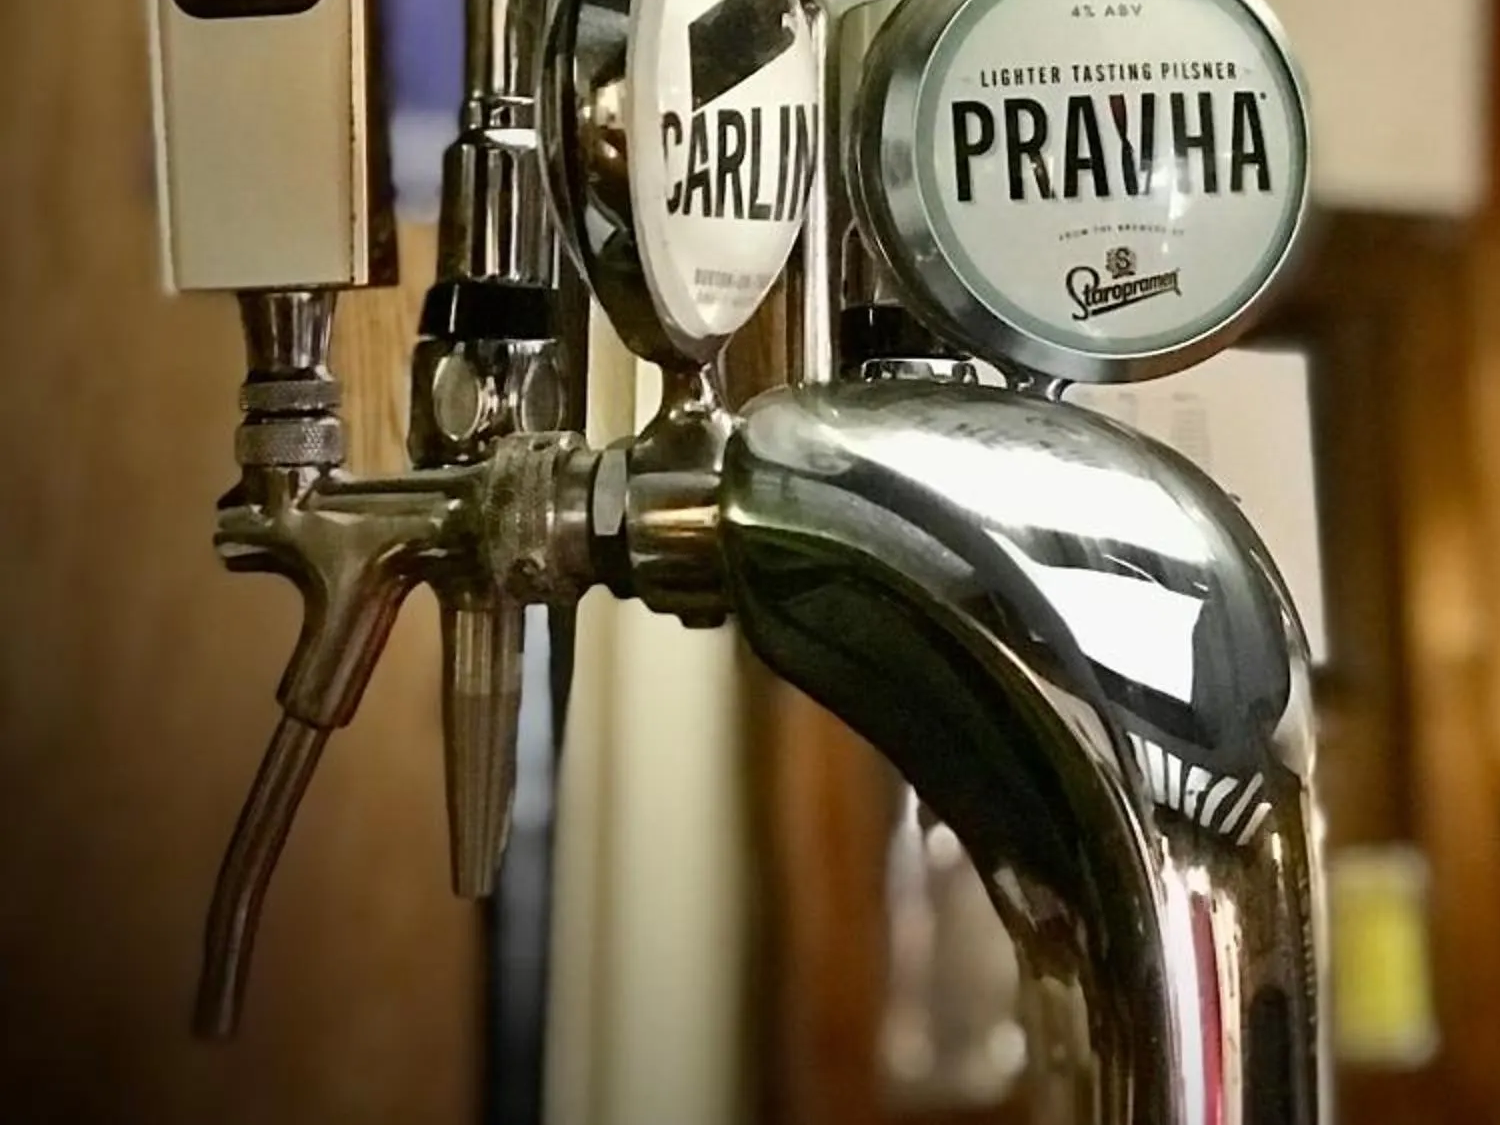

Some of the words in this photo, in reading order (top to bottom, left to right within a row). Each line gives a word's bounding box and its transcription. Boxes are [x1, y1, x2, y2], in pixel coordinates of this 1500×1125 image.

[1104, 3, 1143, 17] ABV
[980, 67, 1061, 88] LIGHTER
[1072, 62, 1152, 83] TASTING
[1161, 61, 1237, 80] PILSNER
[951, 91, 1271, 203] PRAVHA
